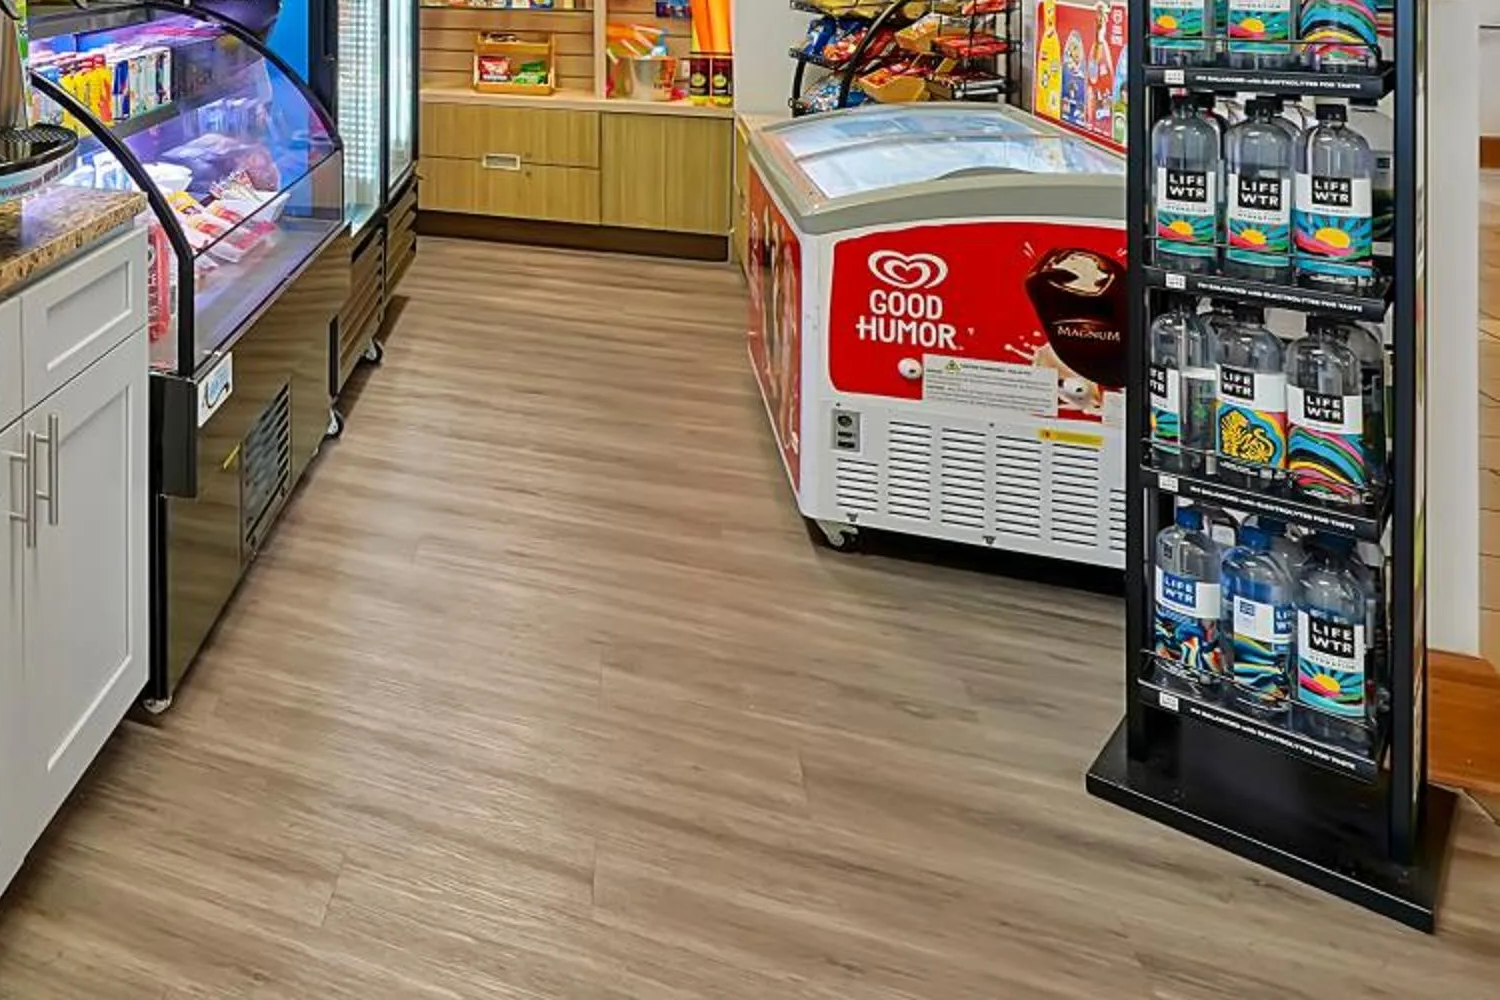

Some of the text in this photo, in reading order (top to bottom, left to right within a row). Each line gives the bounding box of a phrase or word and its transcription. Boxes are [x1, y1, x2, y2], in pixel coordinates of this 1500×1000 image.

[1169, 174, 1205, 186] LIFE
[1241, 180, 1279, 194] LIFE
[1315, 180, 1349, 193] LIFE
[1169, 186, 1205, 199] WTR
[1315, 191, 1349, 203] WTR
[1241, 193, 1280, 208] WTR
[870, 289, 943, 319] GOOD
[856, 315, 957, 350] HUMOR
[1057, 324, 1121, 342] MAGNUM
[1222, 371, 1251, 385] LIFE
[1306, 395, 1341, 409] LIFE
[1306, 407, 1343, 421] WTR
[1164, 577, 1193, 593] LIFE
[1164, 588, 1195, 603] WTR
[1312, 622, 1353, 641] LIFE
[1312, 635, 1353, 654] WTR
